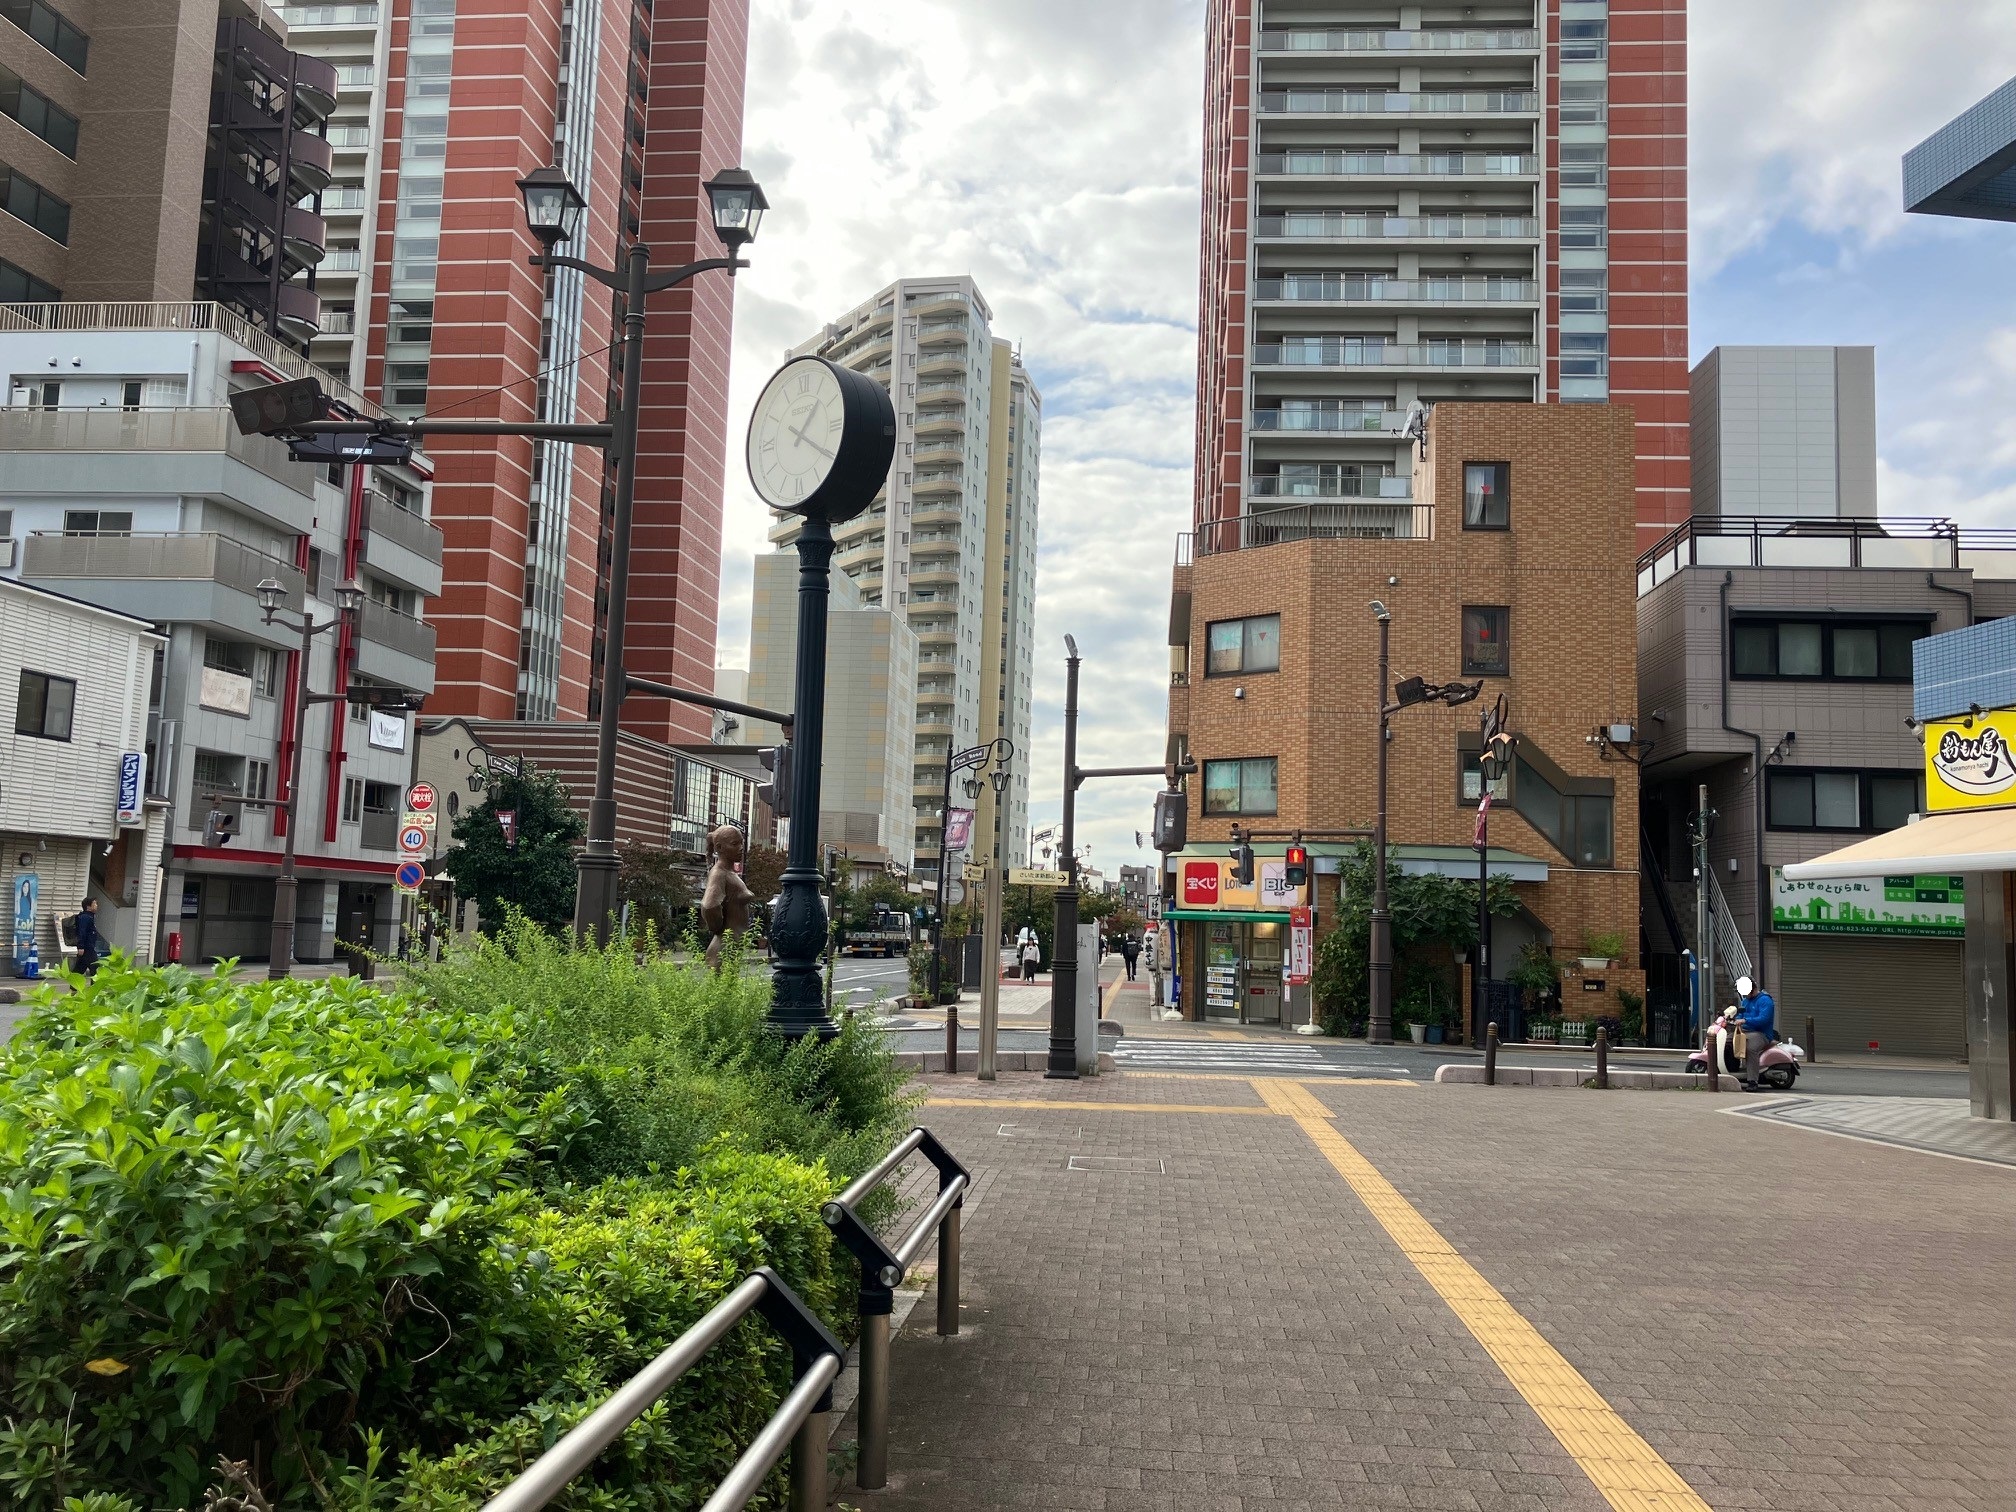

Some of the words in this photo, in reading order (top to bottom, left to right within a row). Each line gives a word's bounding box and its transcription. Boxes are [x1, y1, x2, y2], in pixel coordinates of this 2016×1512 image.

[791, 403, 815, 417] SEIKO
[119, 754, 138, 809] アパマンショップ
[412, 792, 432, 803] 消火栓
[405, 832, 421, 845] 40
[1019, 872, 1056, 880] さいたま新都心
[1186, 877, 1217, 890] 宝くじ
[1264, 877, 1295, 891] BIG
[1779, 881, 1871, 895] しあわせのとびら探し
[1151, 896, 1160, 917] つけ麺
[1144, 936, 1154, 967] 中華そば
